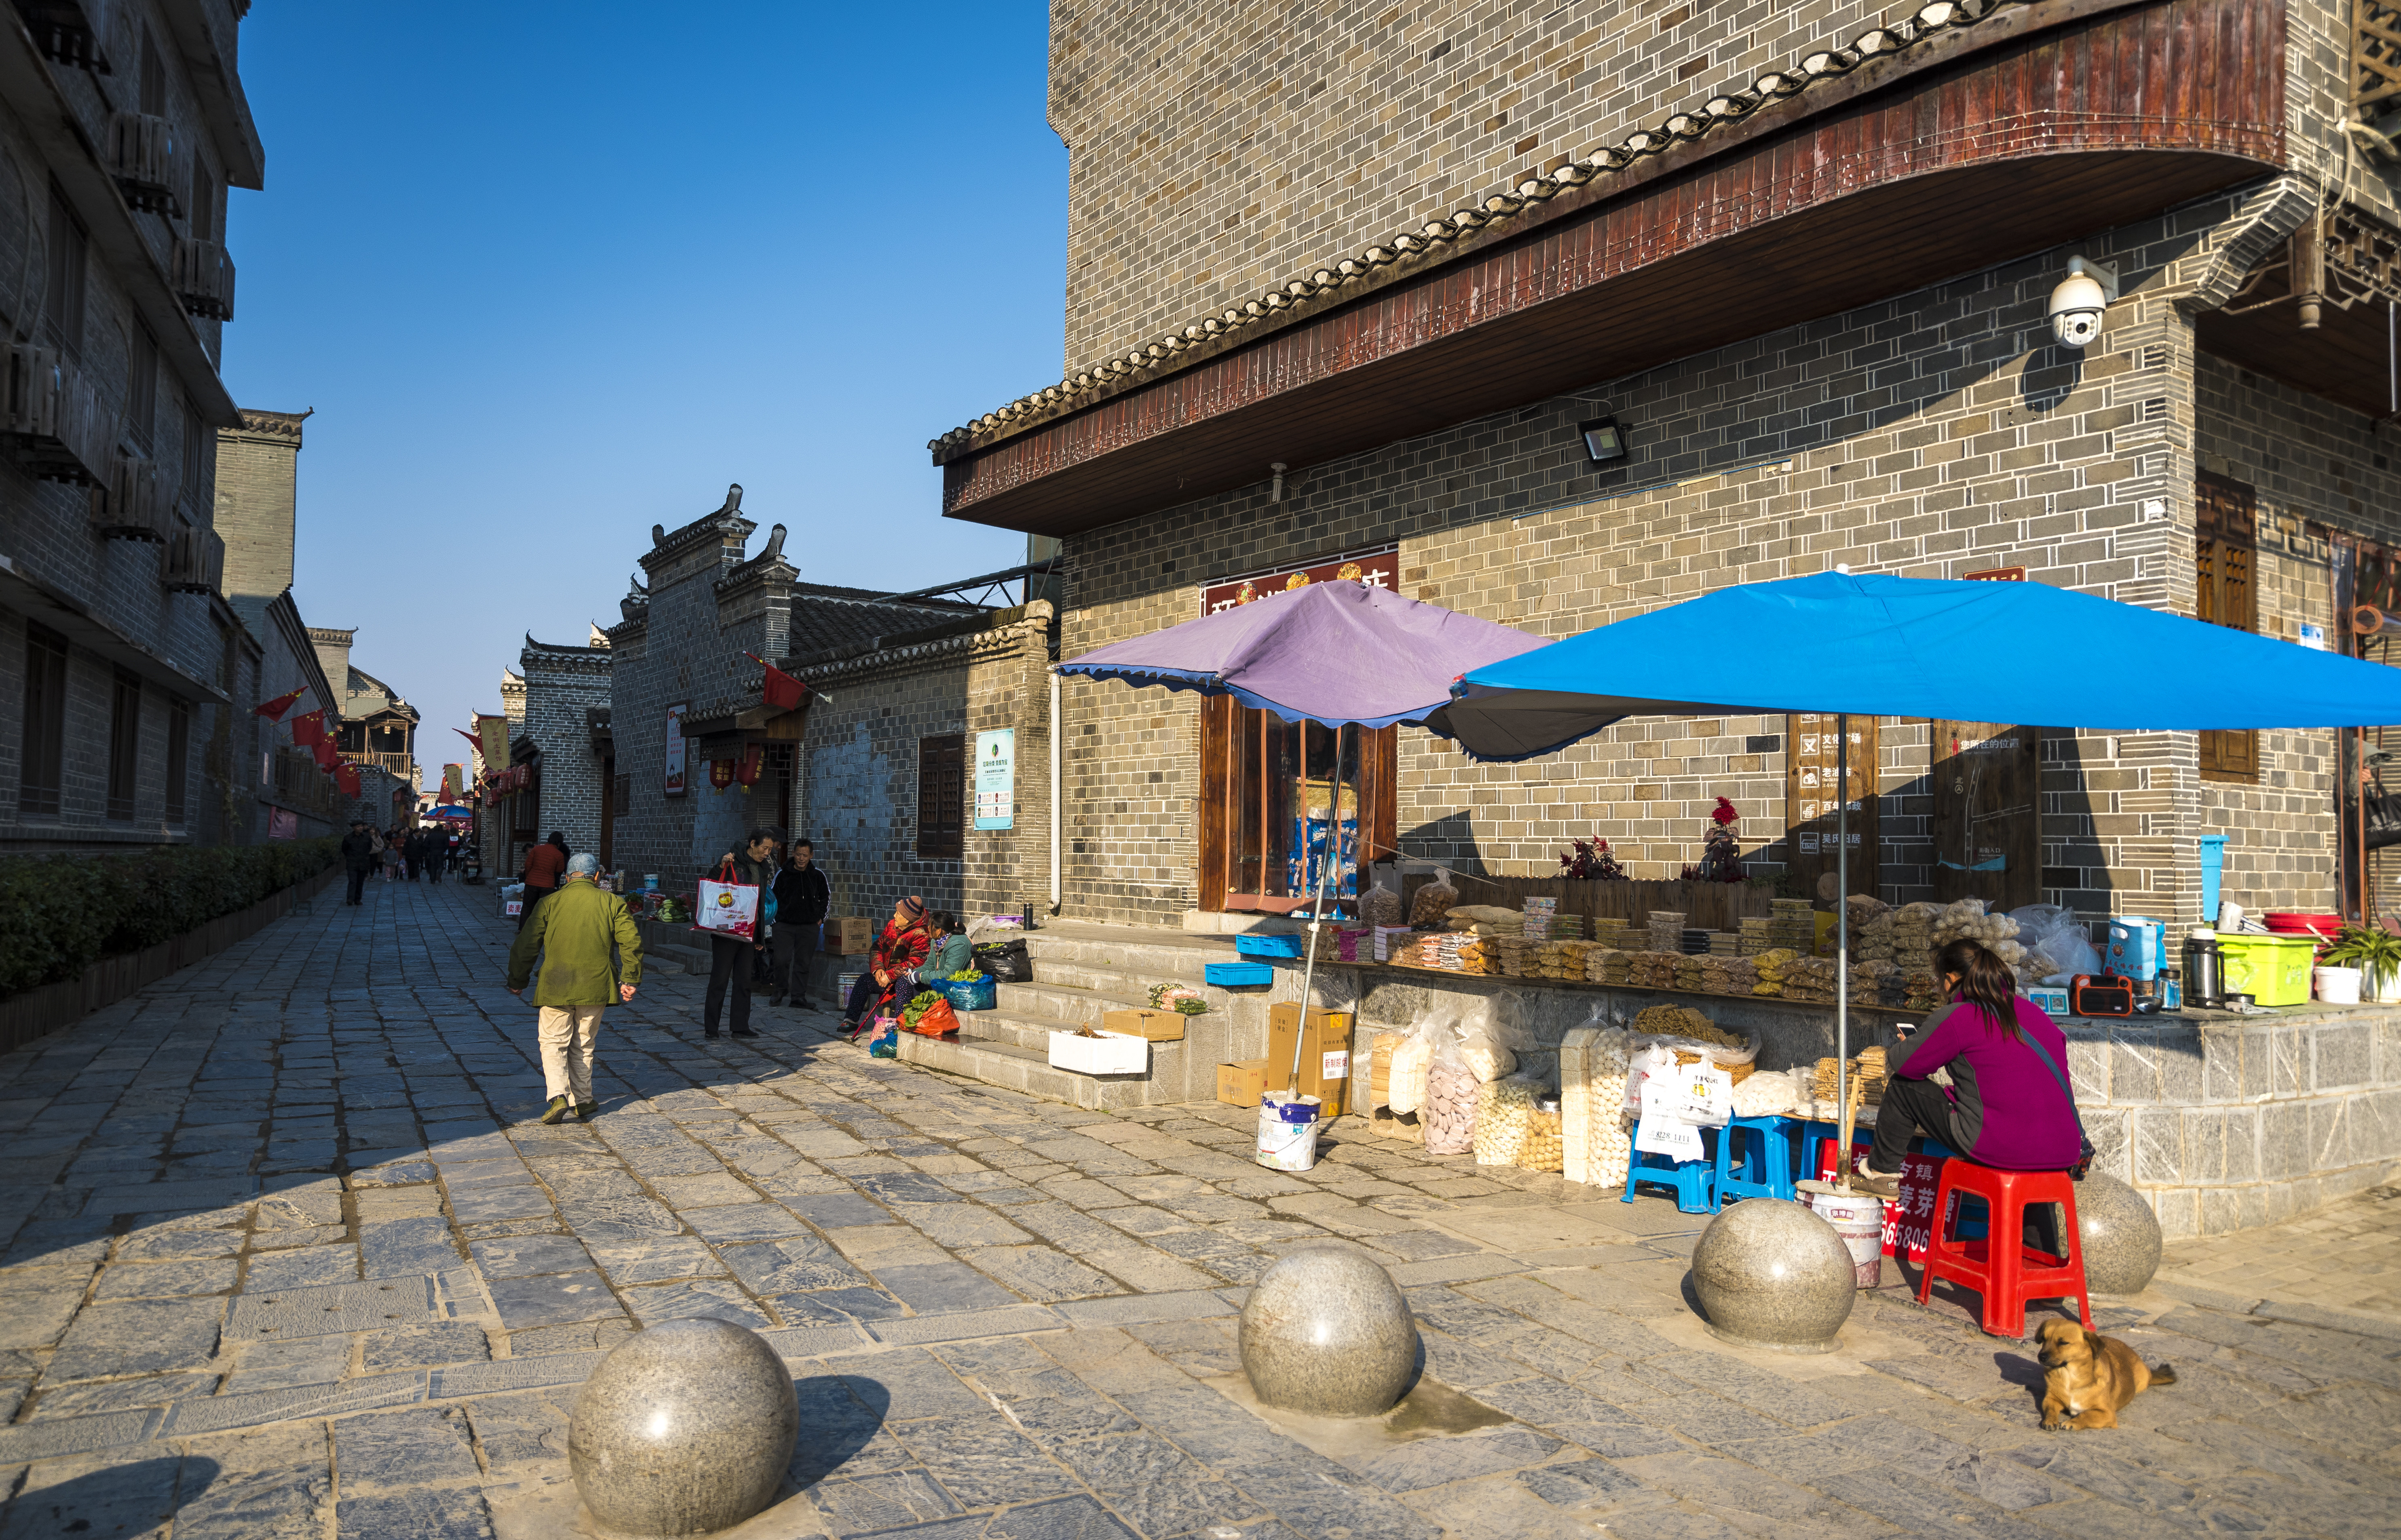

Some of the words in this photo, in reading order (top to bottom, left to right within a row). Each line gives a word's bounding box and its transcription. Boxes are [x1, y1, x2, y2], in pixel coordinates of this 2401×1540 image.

[492, 731, 502, 762] 老街土菜馆
[1961, 738, 2019, 750] 您所在的位置
[507, 904, 522, 913] 卖麦
